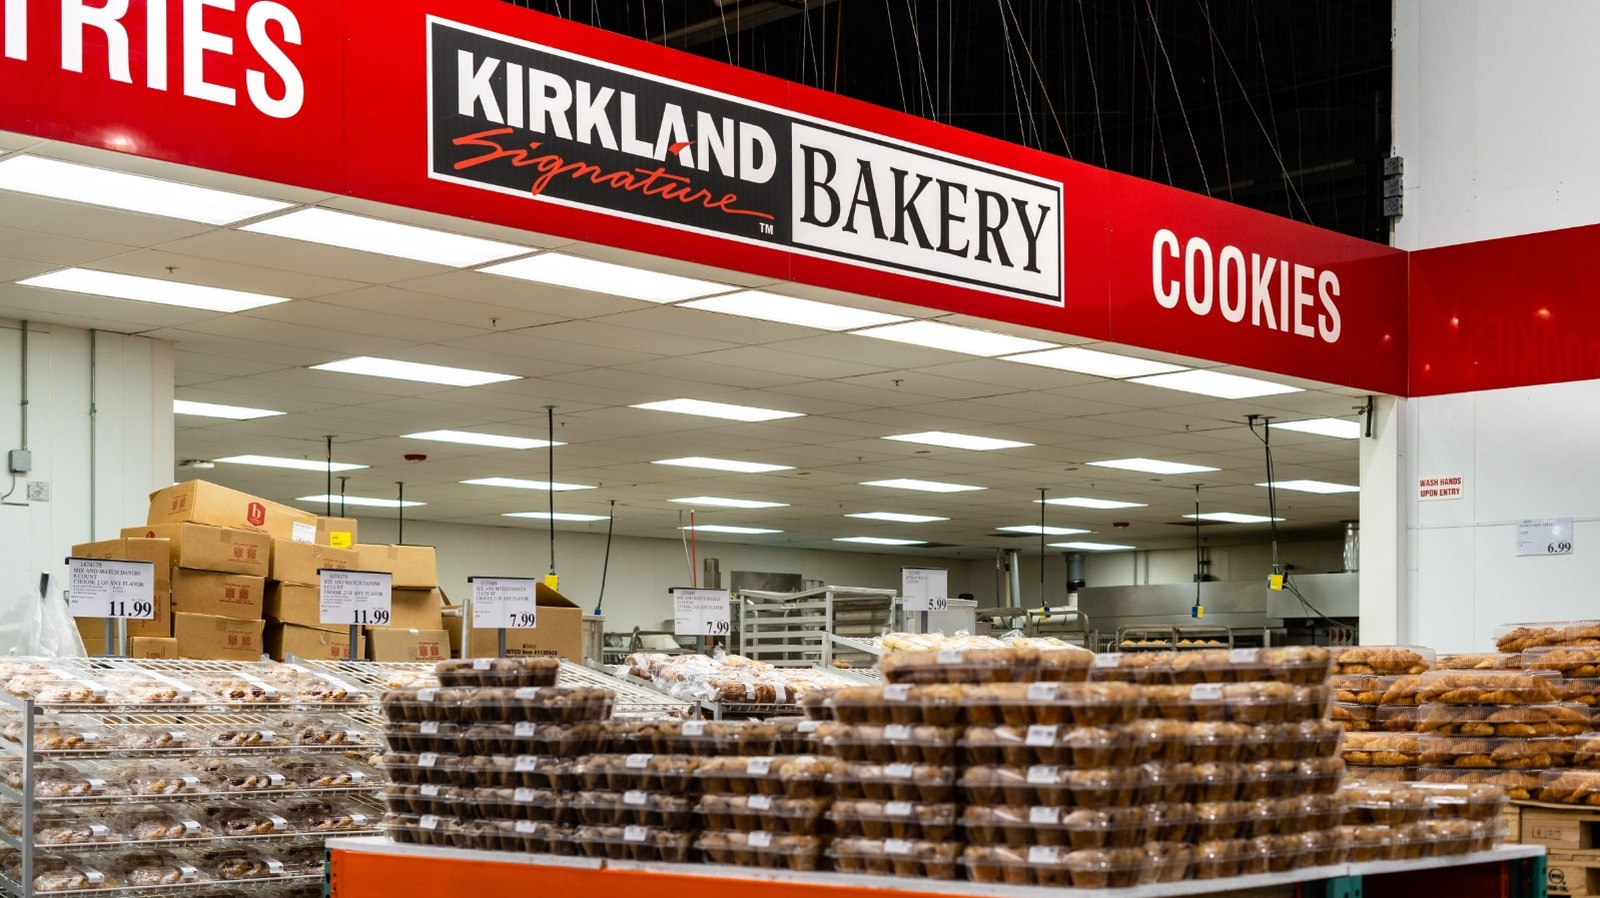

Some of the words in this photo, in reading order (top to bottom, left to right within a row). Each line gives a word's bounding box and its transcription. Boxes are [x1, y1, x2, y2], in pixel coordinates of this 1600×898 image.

[457, 49, 777, 184] KIRKLAND
[452, 127, 775, 196] Signature
[799, 143, 1051, 275] BAKERY
[759, 221, 774, 235] TM
[1152, 228, 1341, 344] COOKIES
[1420, 479, 1439, 487] WASH
[1440, 477, 1462, 486] HANDS
[1440, 488, 1460, 496] ENTRY
[1548, 542, 1571, 554] 6.99
[109, 601, 152, 617] 11.99
[929, 599, 946, 610] 5.99
[353, 610, 389, 624] 11.99
[510, 614, 535, 627] 7.99
[707, 621, 729, 634] 7.99
